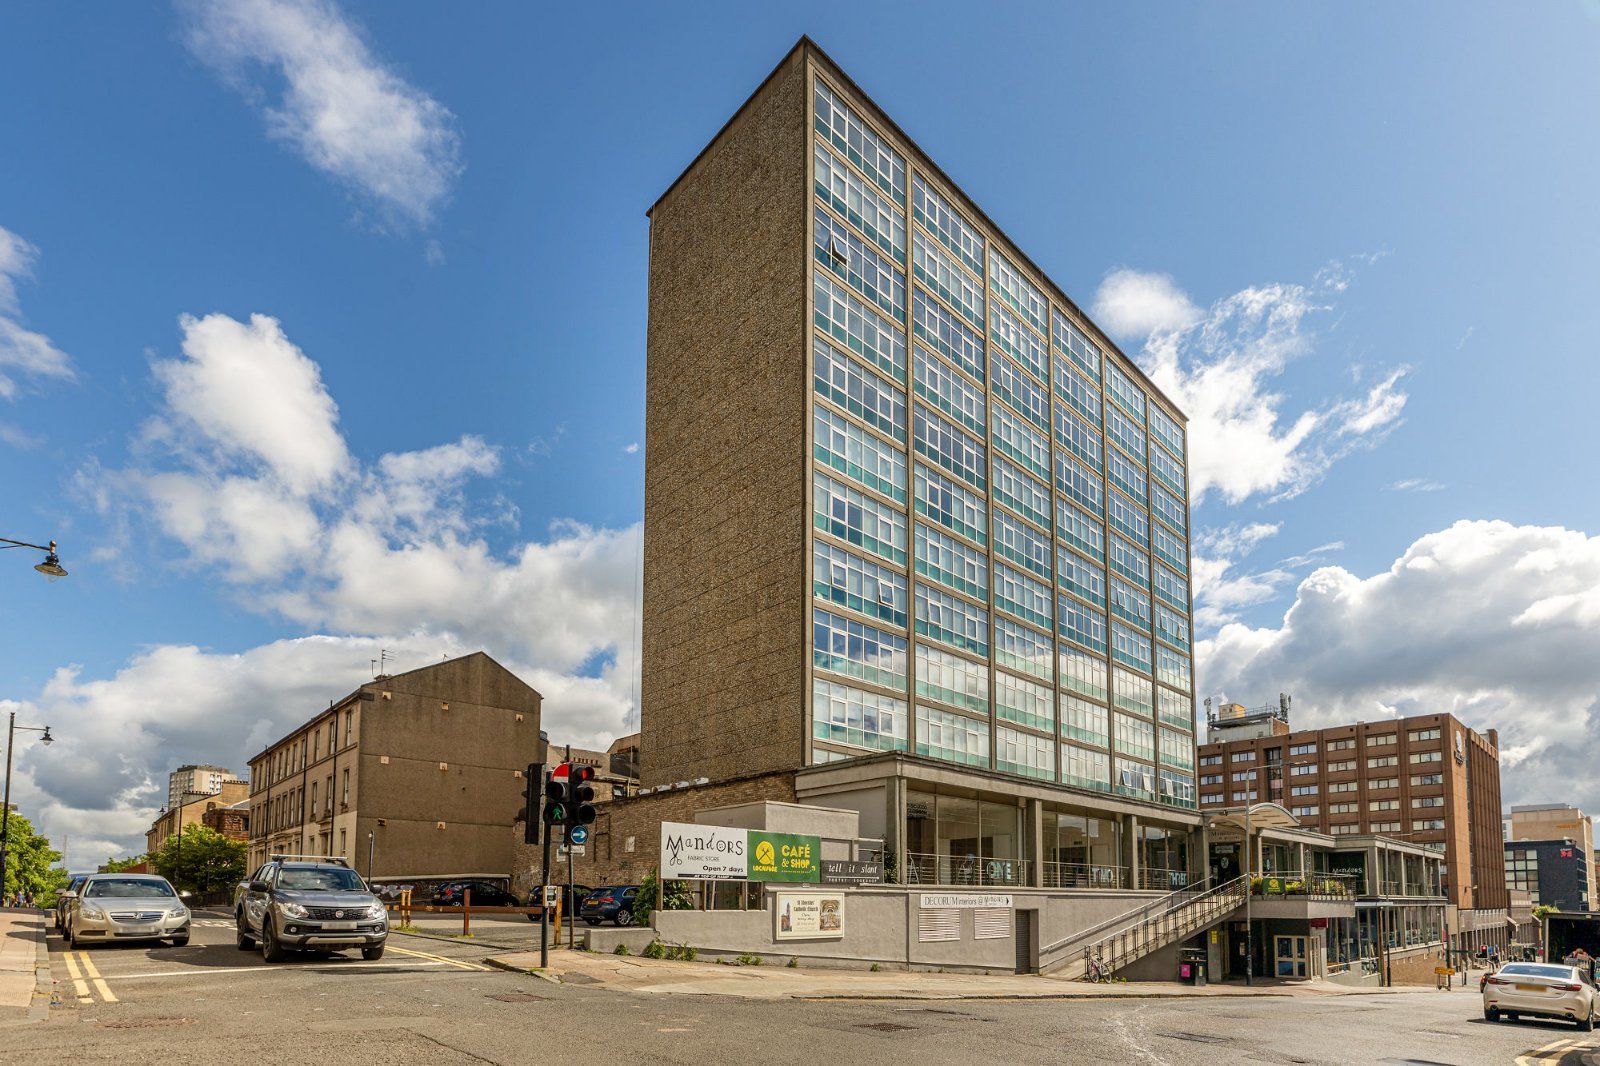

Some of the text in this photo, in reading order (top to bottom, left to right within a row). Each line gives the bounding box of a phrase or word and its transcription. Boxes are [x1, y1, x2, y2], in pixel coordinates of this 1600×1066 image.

[781, 843, 810, 858] CAFÉ
[781, 858, 810, 869] & SHOP
[828, 863, 878, 873] tell it slant
[924, 896, 958, 905] DECORUM
